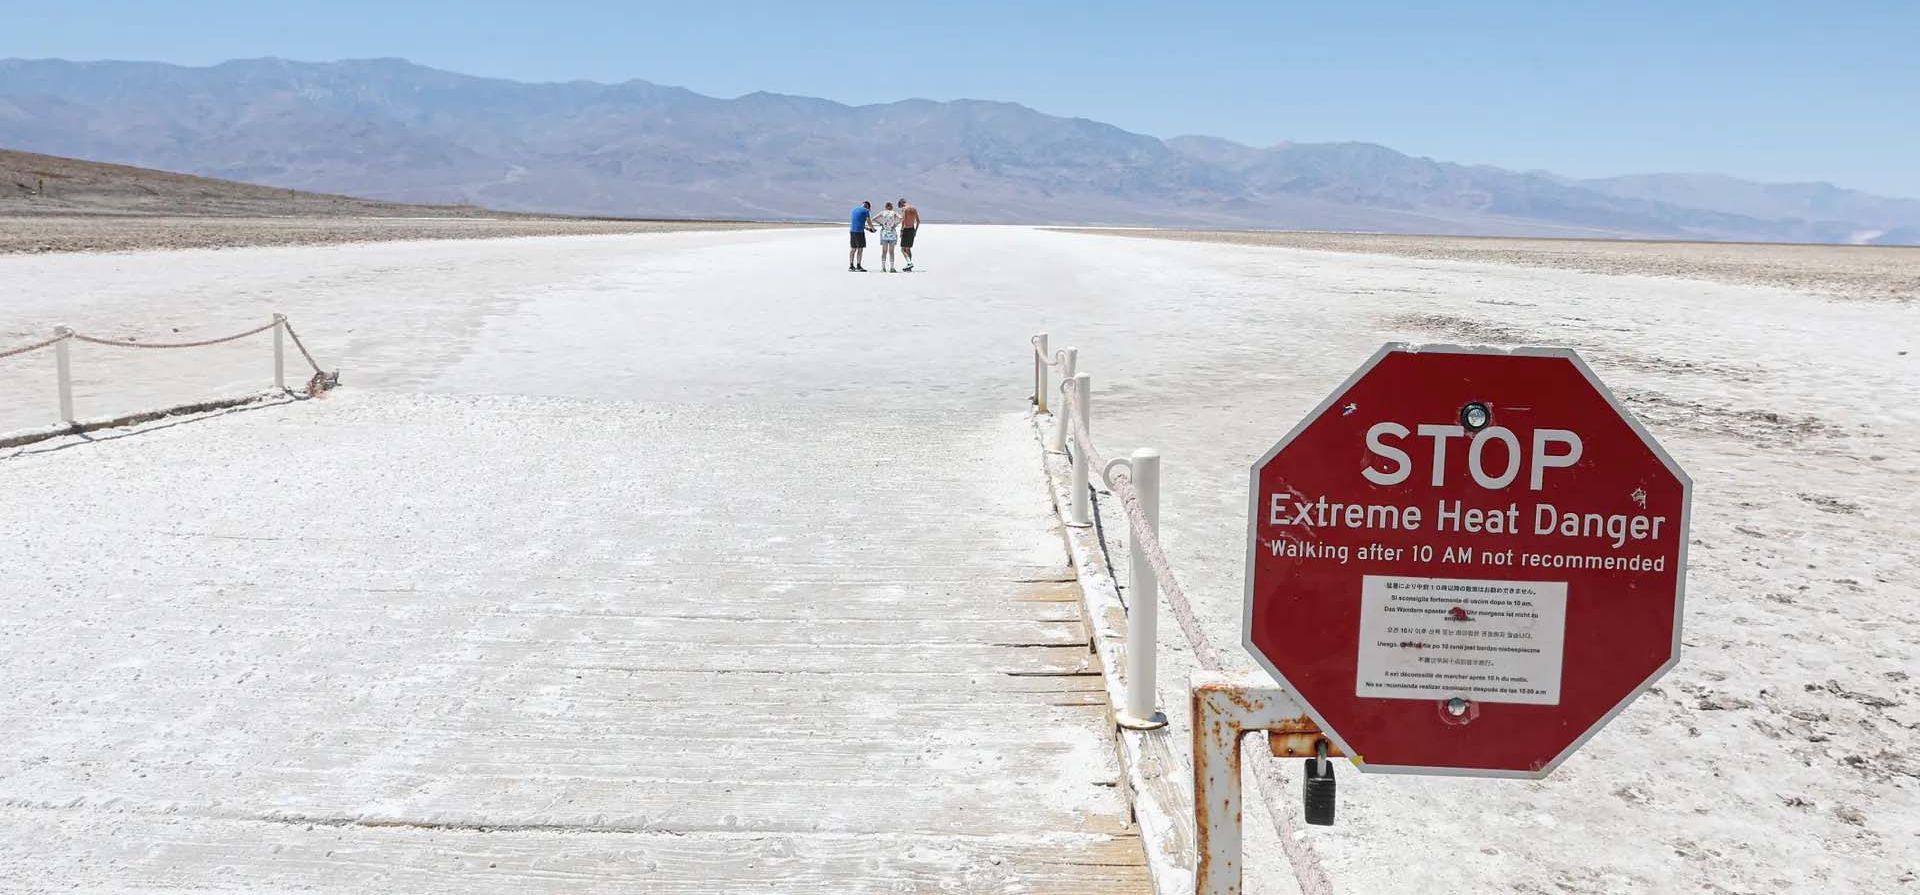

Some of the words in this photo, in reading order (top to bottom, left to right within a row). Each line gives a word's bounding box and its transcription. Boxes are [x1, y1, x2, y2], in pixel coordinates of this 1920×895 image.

[1361, 421, 1584, 491] STOP
[1270, 493, 1421, 531] Extreme
[1437, 499, 1520, 534] Heat
[1534, 503, 1666, 549] Danger
[1271, 539, 1349, 564] Walking
[1357, 543, 1403, 562] after
[1412, 545, 1433, 562] 10
[1441, 546, 1473, 564] AM
[1481, 549, 1514, 566] not
[1521, 553, 1665, 572] recommended
